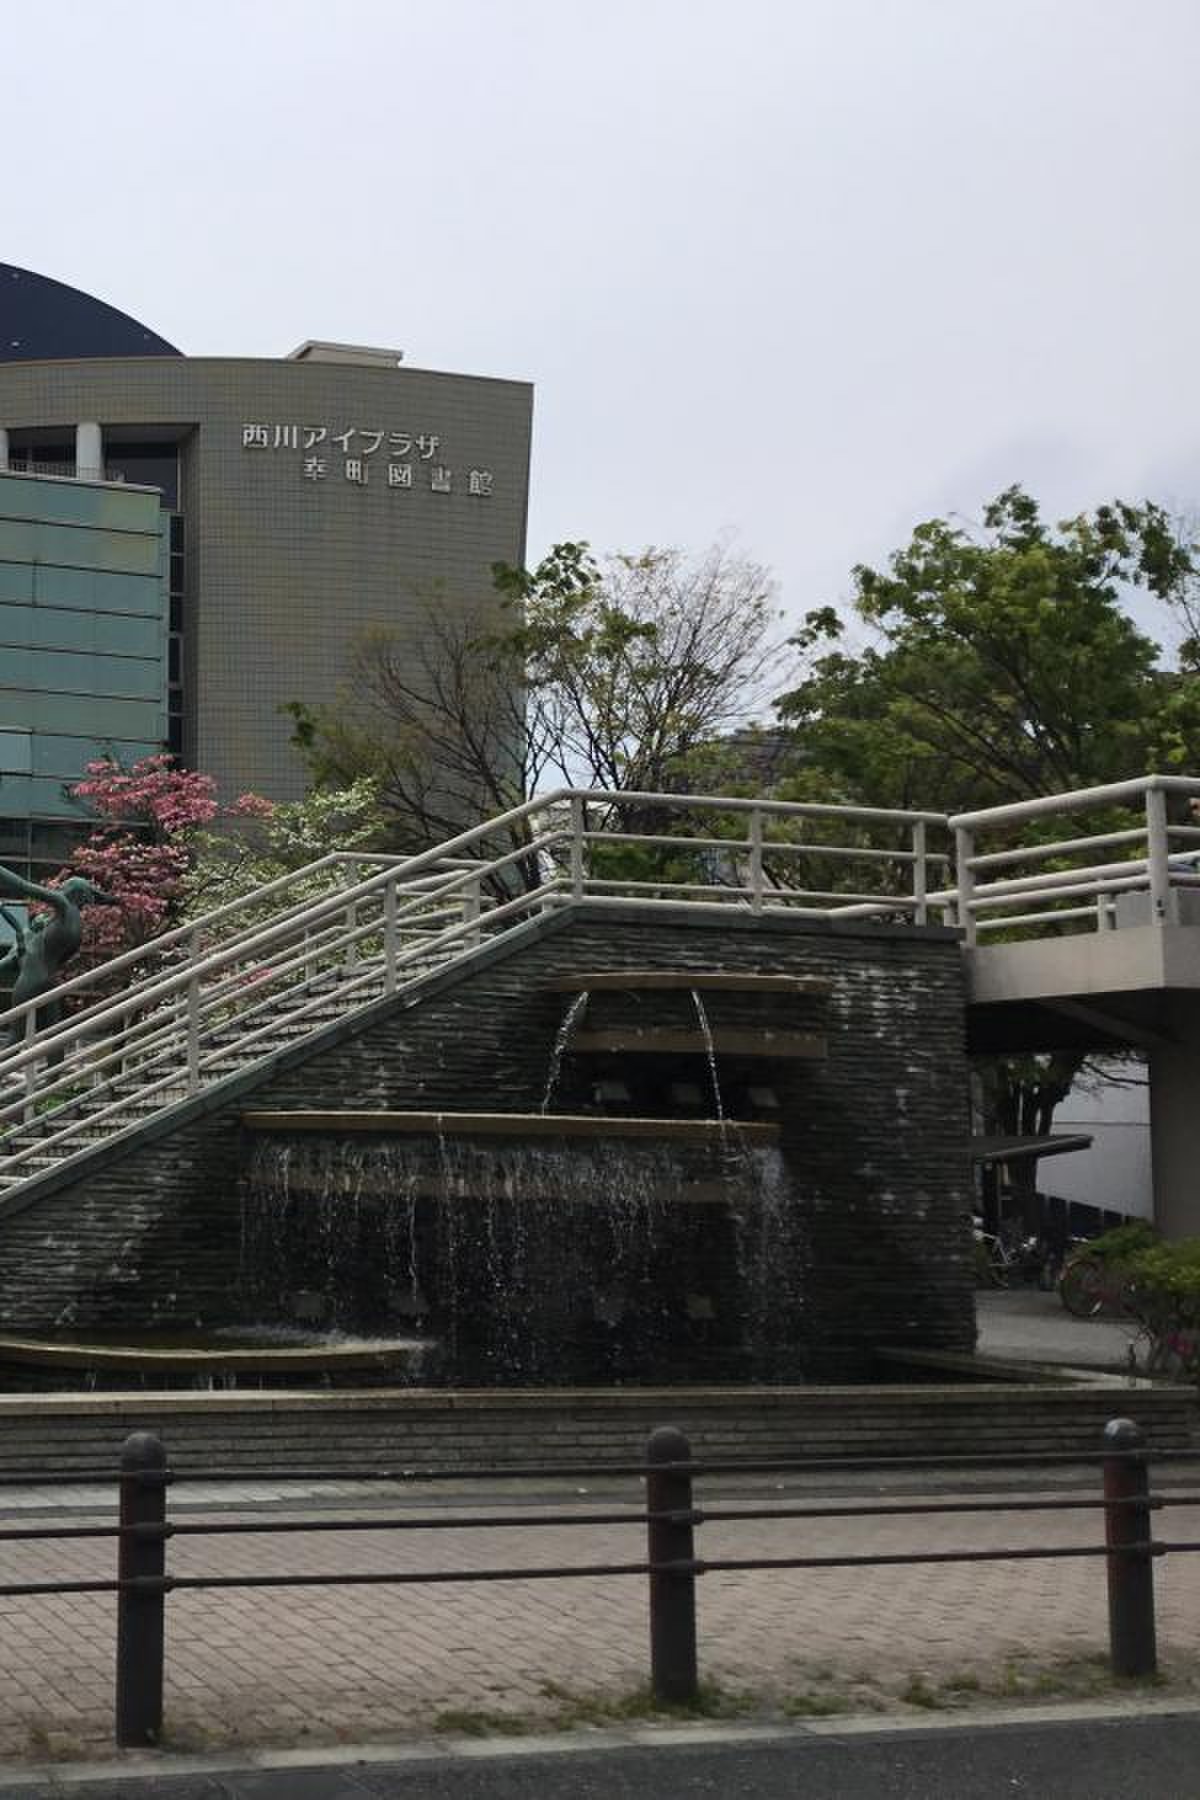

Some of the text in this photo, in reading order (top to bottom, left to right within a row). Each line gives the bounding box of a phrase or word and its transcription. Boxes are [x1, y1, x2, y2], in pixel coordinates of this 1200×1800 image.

[303, 456, 493, 496] 幸町図書館
